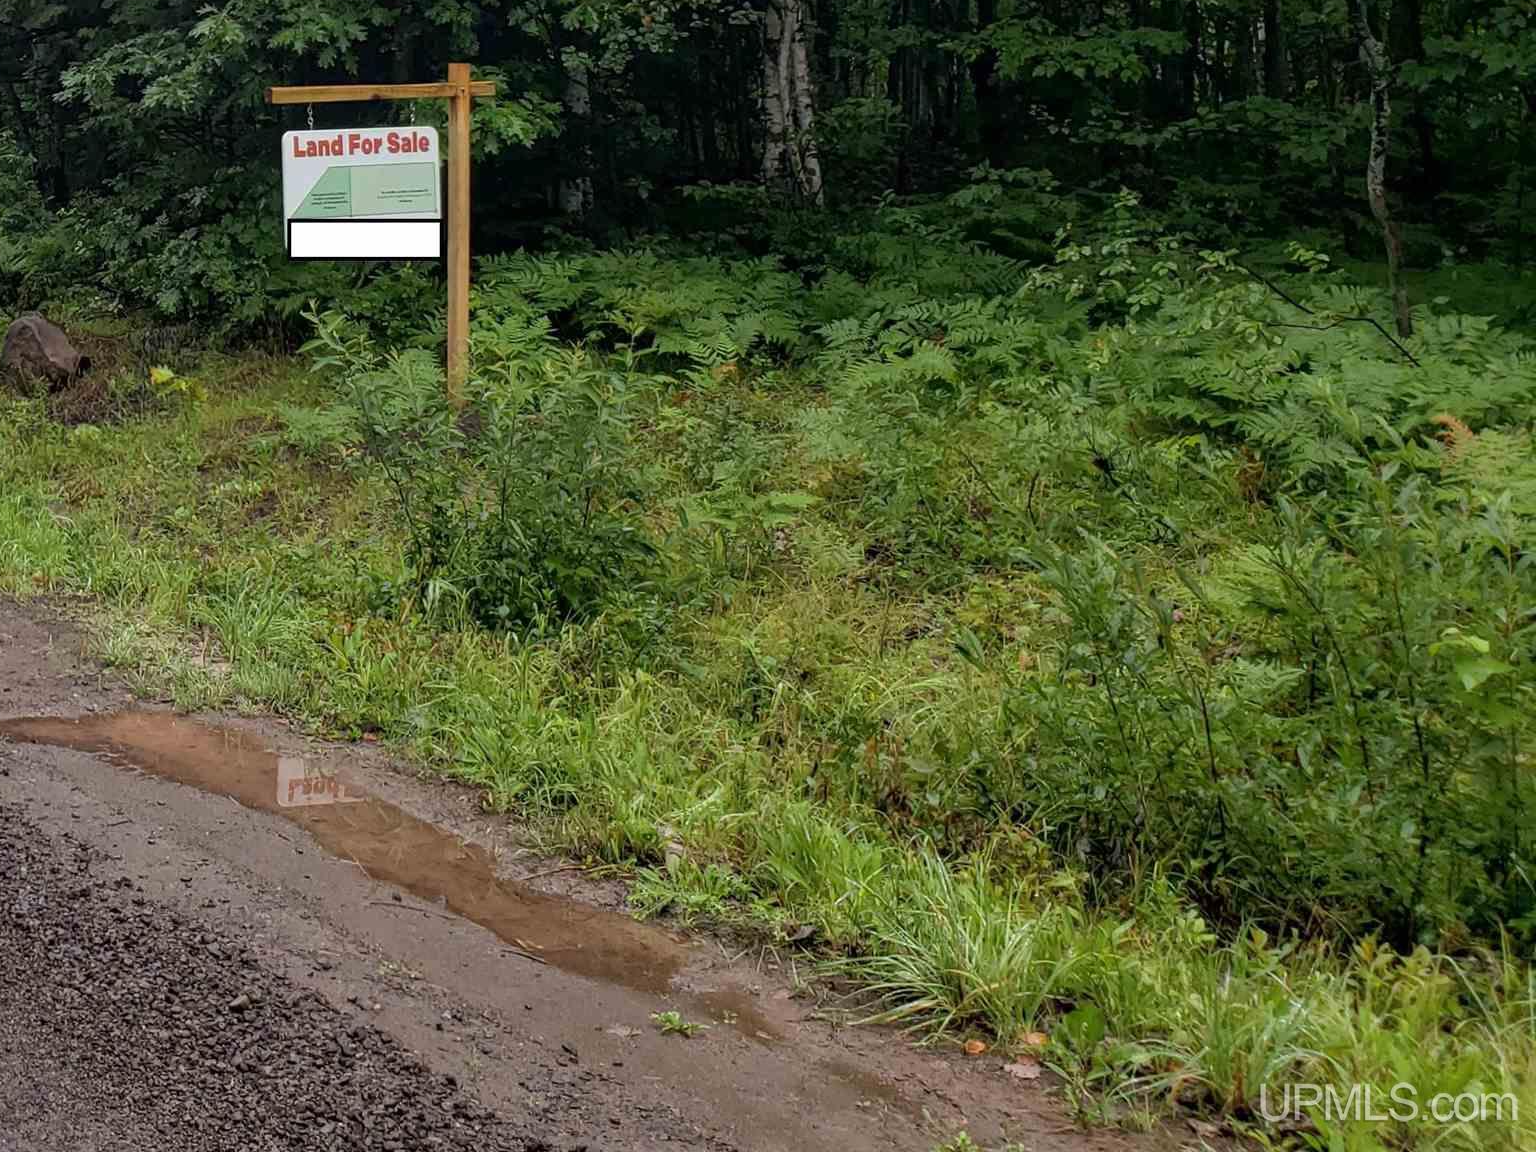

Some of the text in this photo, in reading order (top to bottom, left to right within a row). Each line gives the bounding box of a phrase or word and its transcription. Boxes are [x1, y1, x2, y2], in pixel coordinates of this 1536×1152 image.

[293, 131, 430, 158] Land For Sale
